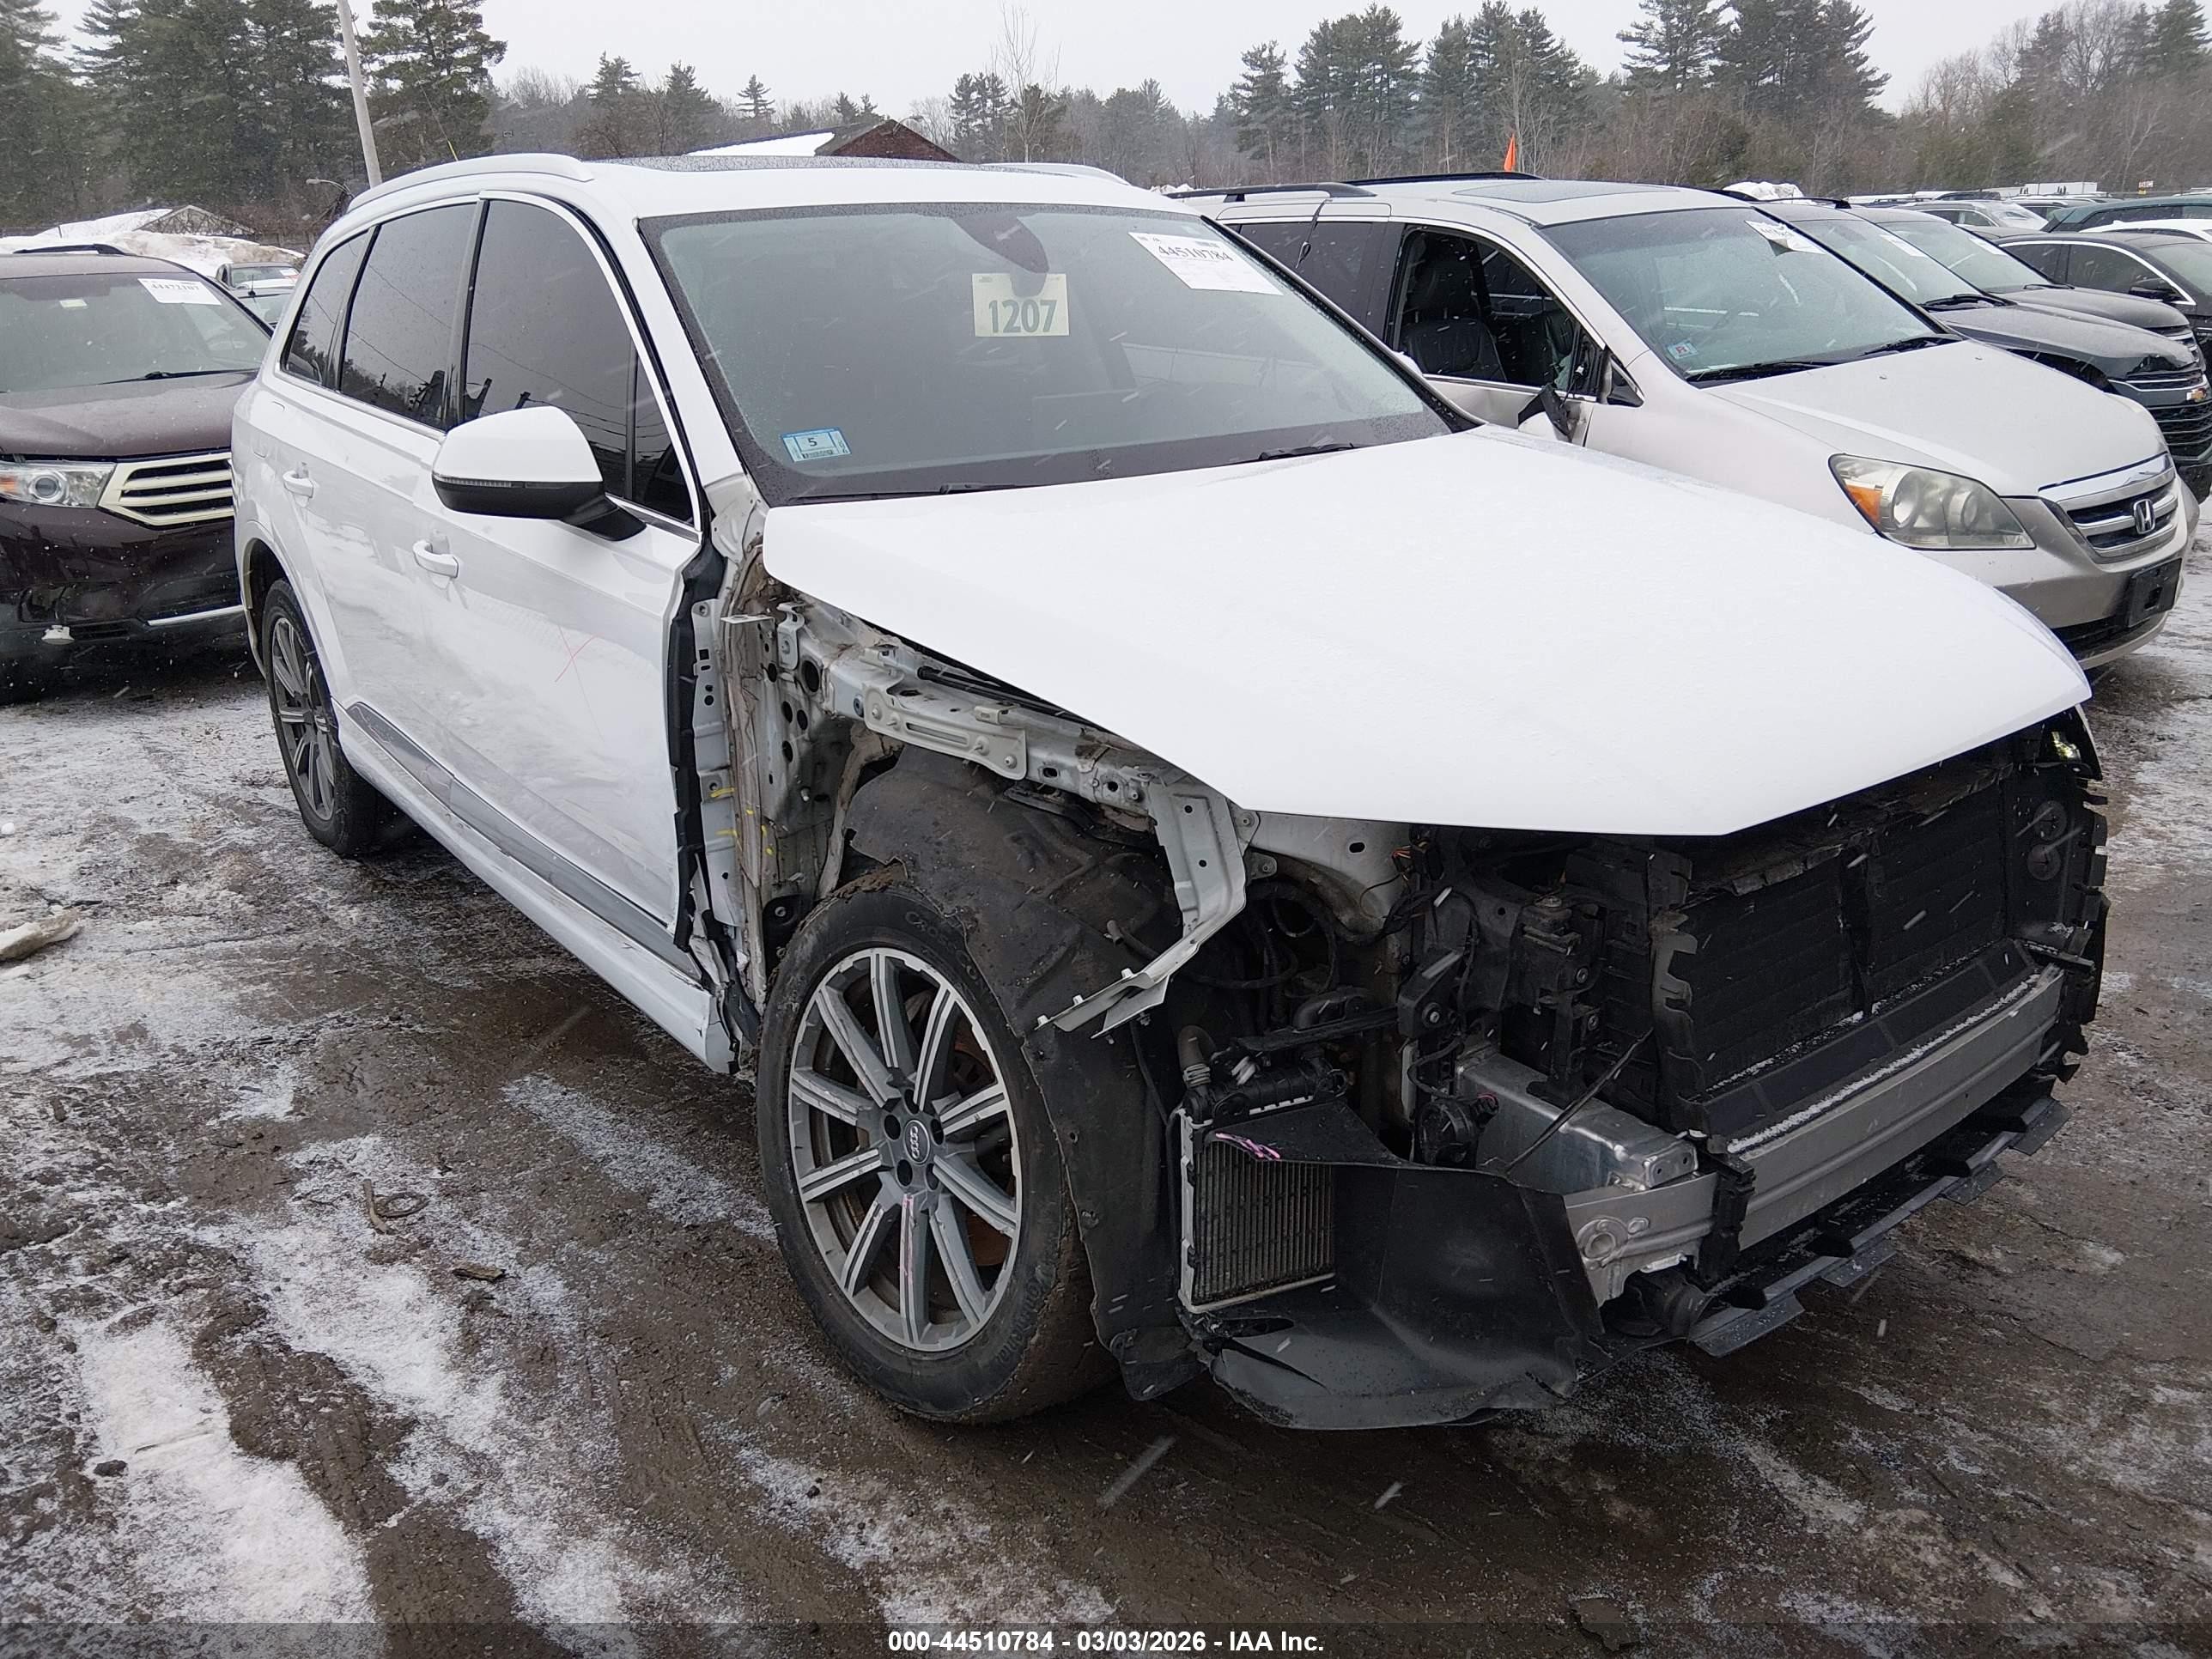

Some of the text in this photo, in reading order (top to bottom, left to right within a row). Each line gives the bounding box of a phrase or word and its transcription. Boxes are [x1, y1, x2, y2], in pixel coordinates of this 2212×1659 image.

[1158, 246, 1234, 261] 44510784
[988, 299, 1057, 333] 1207
[807, 437, 818, 447] 5
